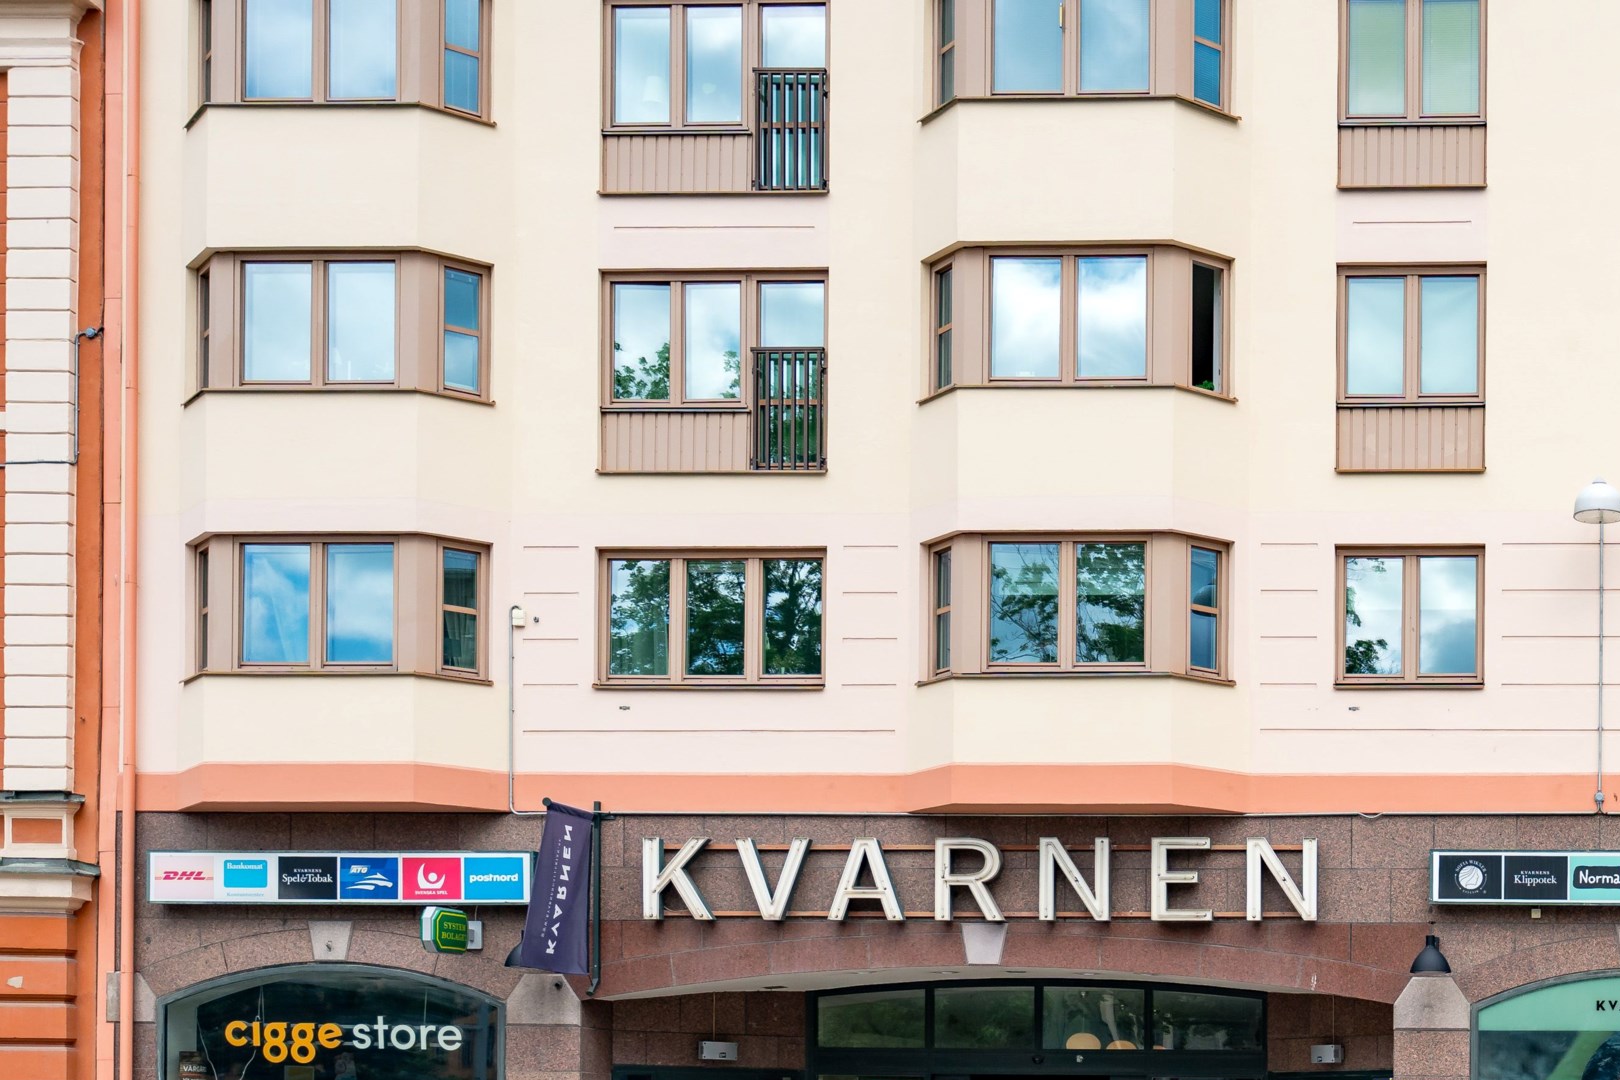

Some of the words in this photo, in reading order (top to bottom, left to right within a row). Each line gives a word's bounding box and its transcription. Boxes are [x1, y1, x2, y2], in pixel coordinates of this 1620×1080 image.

[227, 862, 263, 870] Bankomat
[163, 871, 206, 880] DHL
[470, 873, 518, 883] postnord
[641, 837, 1318, 921] KVARNEN
[1514, 875, 1557, 886] Klippotek
[225, 1020, 342, 1063] cigge
[352, 1016, 462, 1050] store
